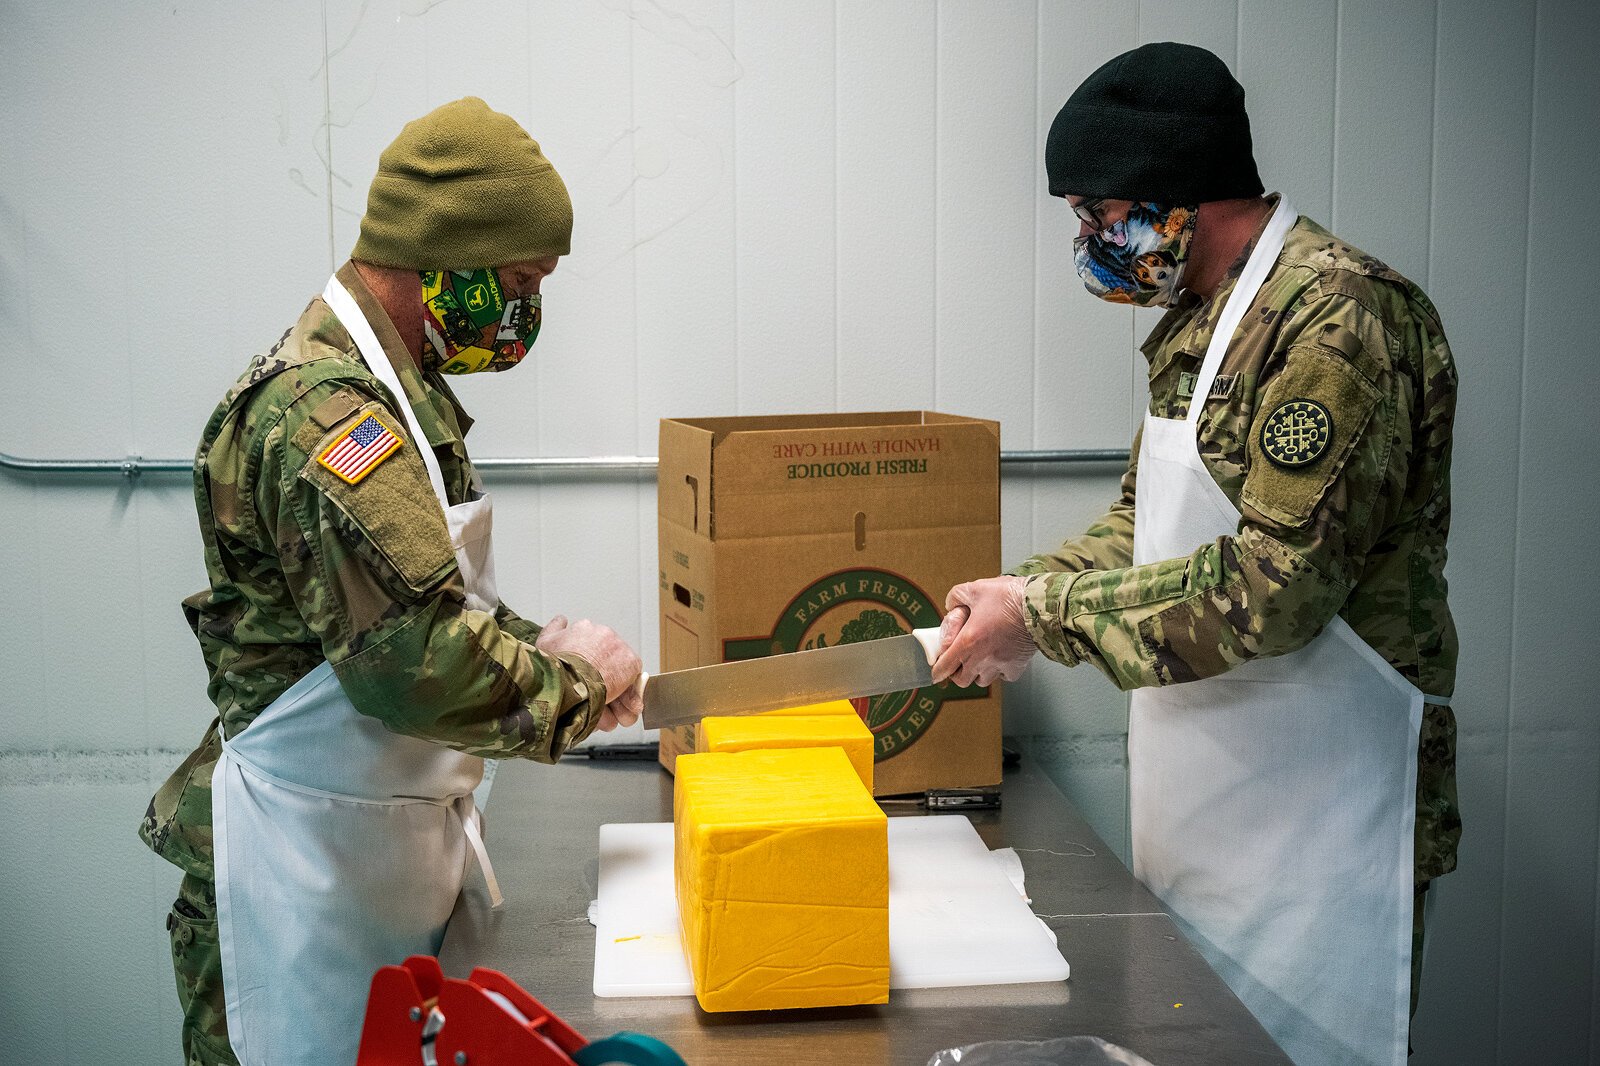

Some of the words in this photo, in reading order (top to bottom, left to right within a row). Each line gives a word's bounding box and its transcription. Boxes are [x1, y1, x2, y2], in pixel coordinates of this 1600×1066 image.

[494, 293, 503, 311] JOHN
[773, 442, 817, 459] CARE
[822, 440, 868, 457] WITH
[872, 437, 941, 454] HANDLE
[787, 460, 871, 480] PRODUCE
[876, 458, 928, 475] FRESH
[794, 581, 849, 624] FARM
[857, 579, 923, 616] FRESH
